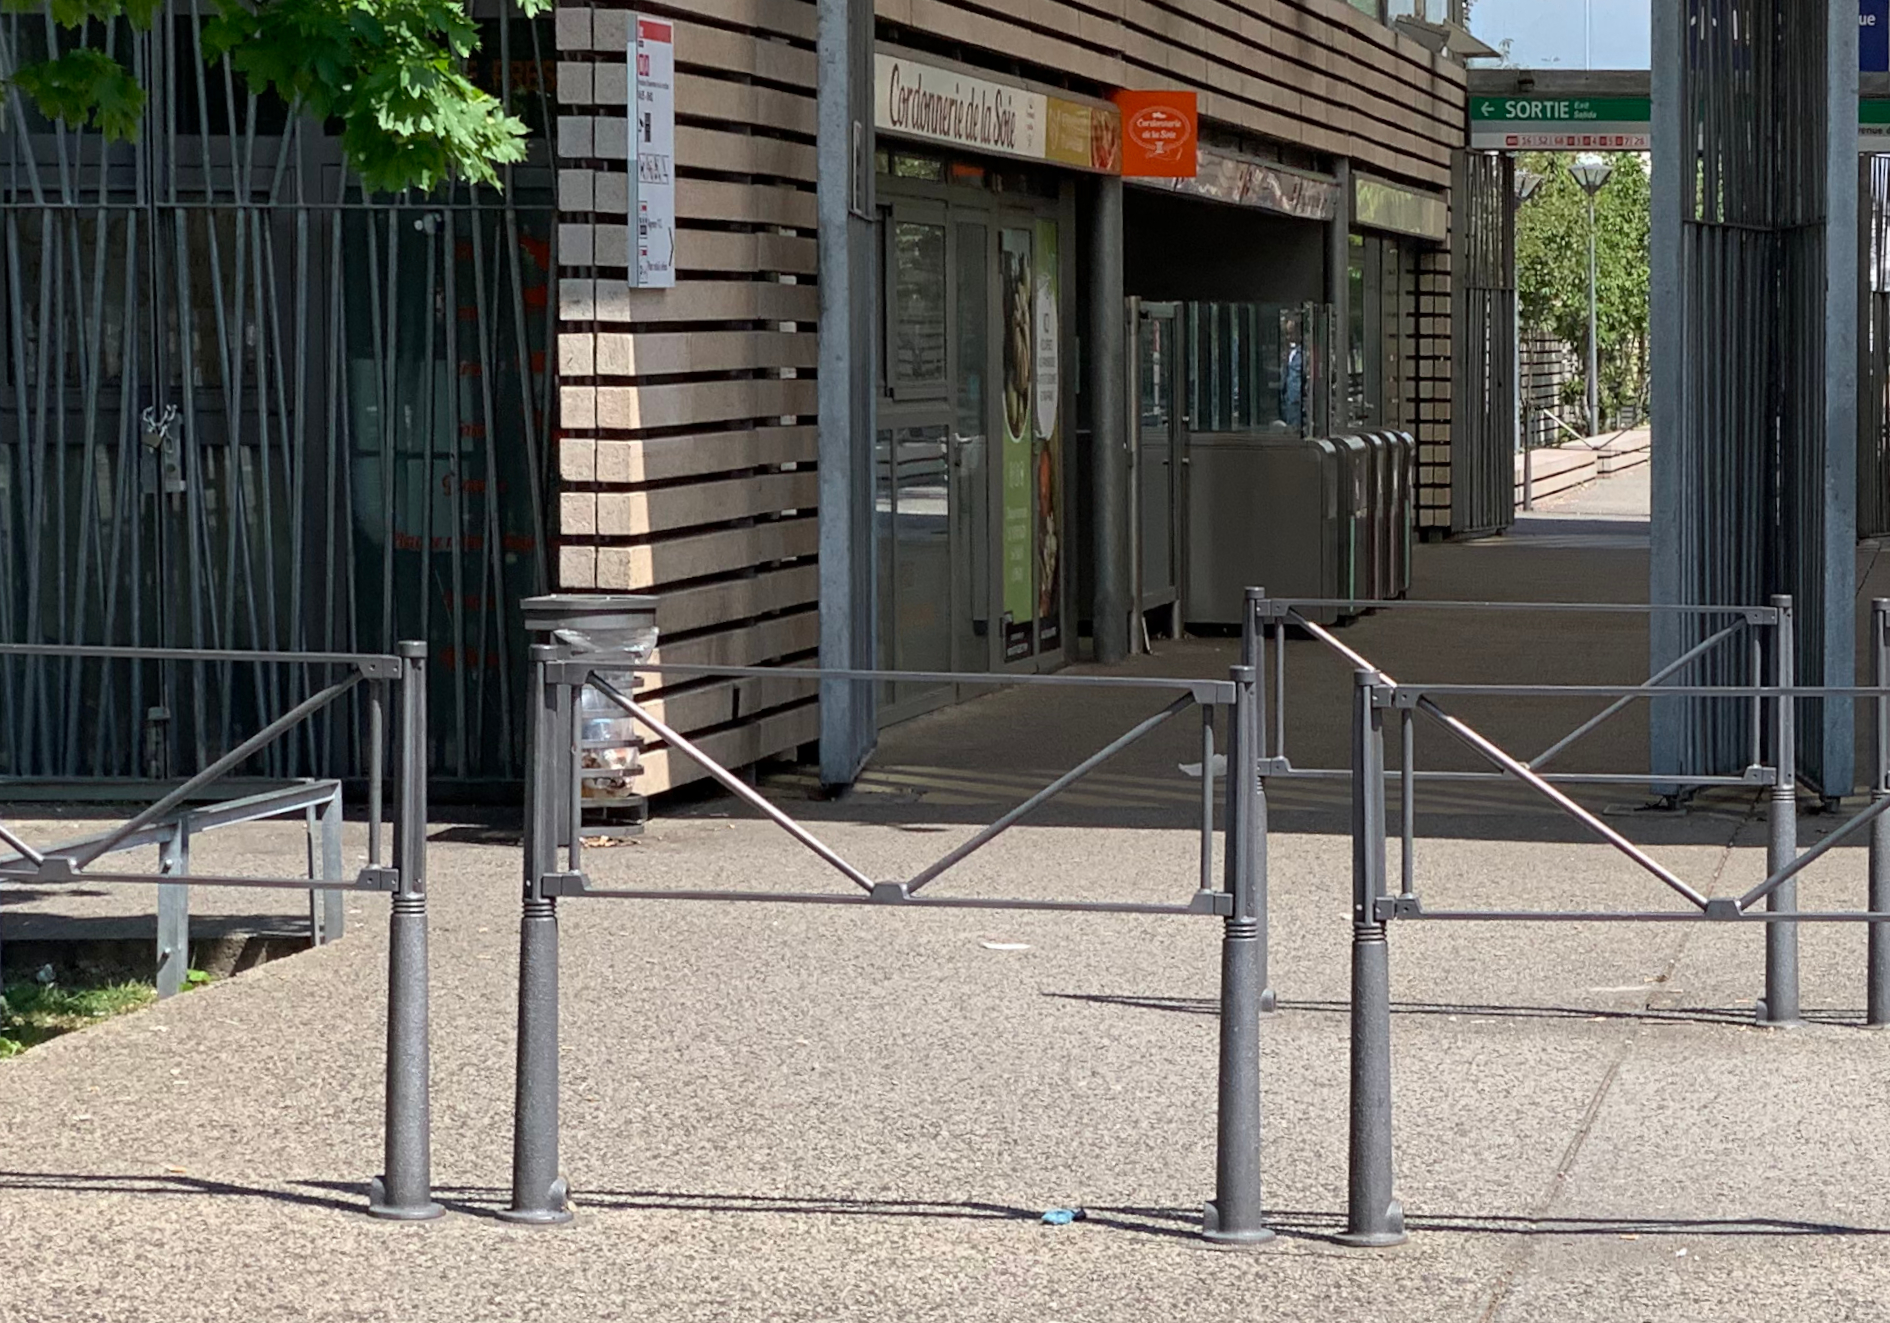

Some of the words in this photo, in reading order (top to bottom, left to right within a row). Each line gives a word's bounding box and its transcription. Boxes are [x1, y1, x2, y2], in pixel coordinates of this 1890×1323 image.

[889, 62, 964, 140] Cordonnerie
[965, 86, 979, 143] de
[980, 89, 991, 145] la
[992, 88, 1016, 150] Soie
[1504, 100, 1570, 119] SORTIE
